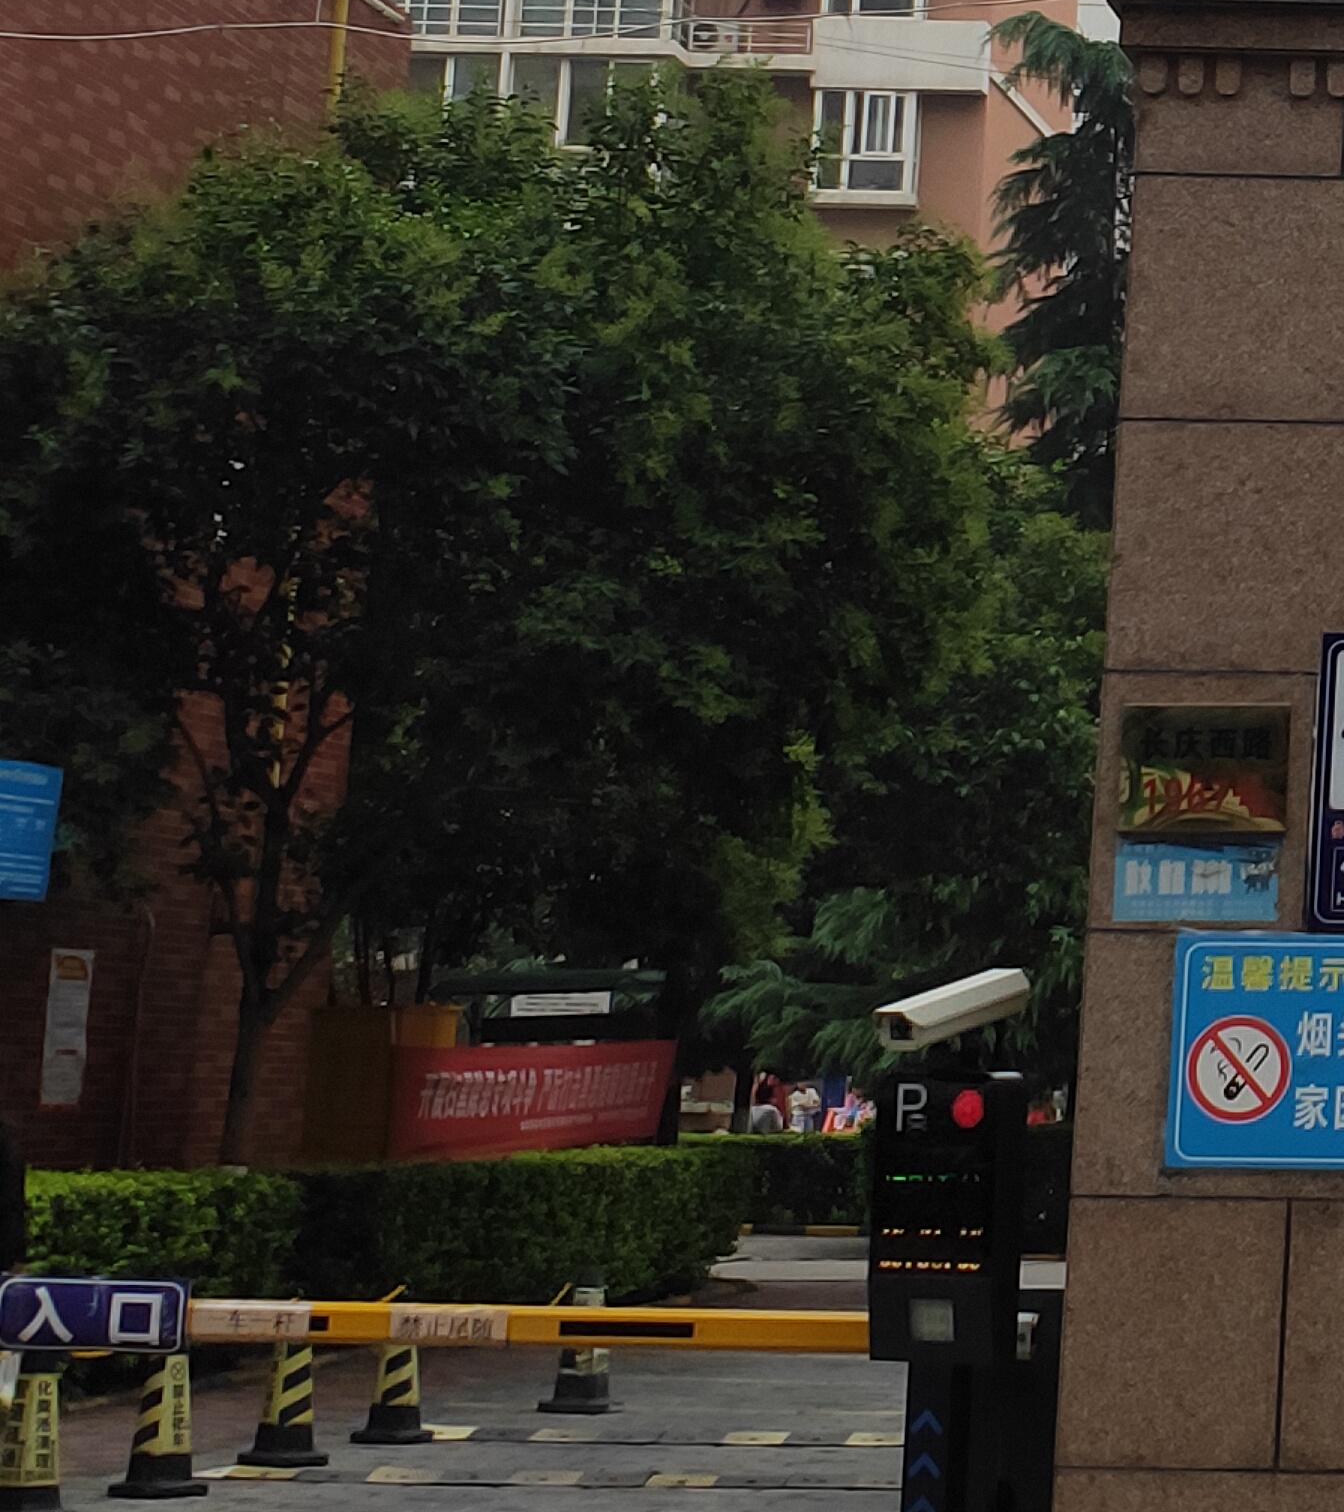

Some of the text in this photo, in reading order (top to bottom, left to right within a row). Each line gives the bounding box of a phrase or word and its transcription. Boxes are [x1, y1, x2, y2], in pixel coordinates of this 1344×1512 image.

[1139, 726, 1271, 760] 长庆西路
[896, 1083, 928, 1133] P
[17, 1285, 164, 1346] 入口
